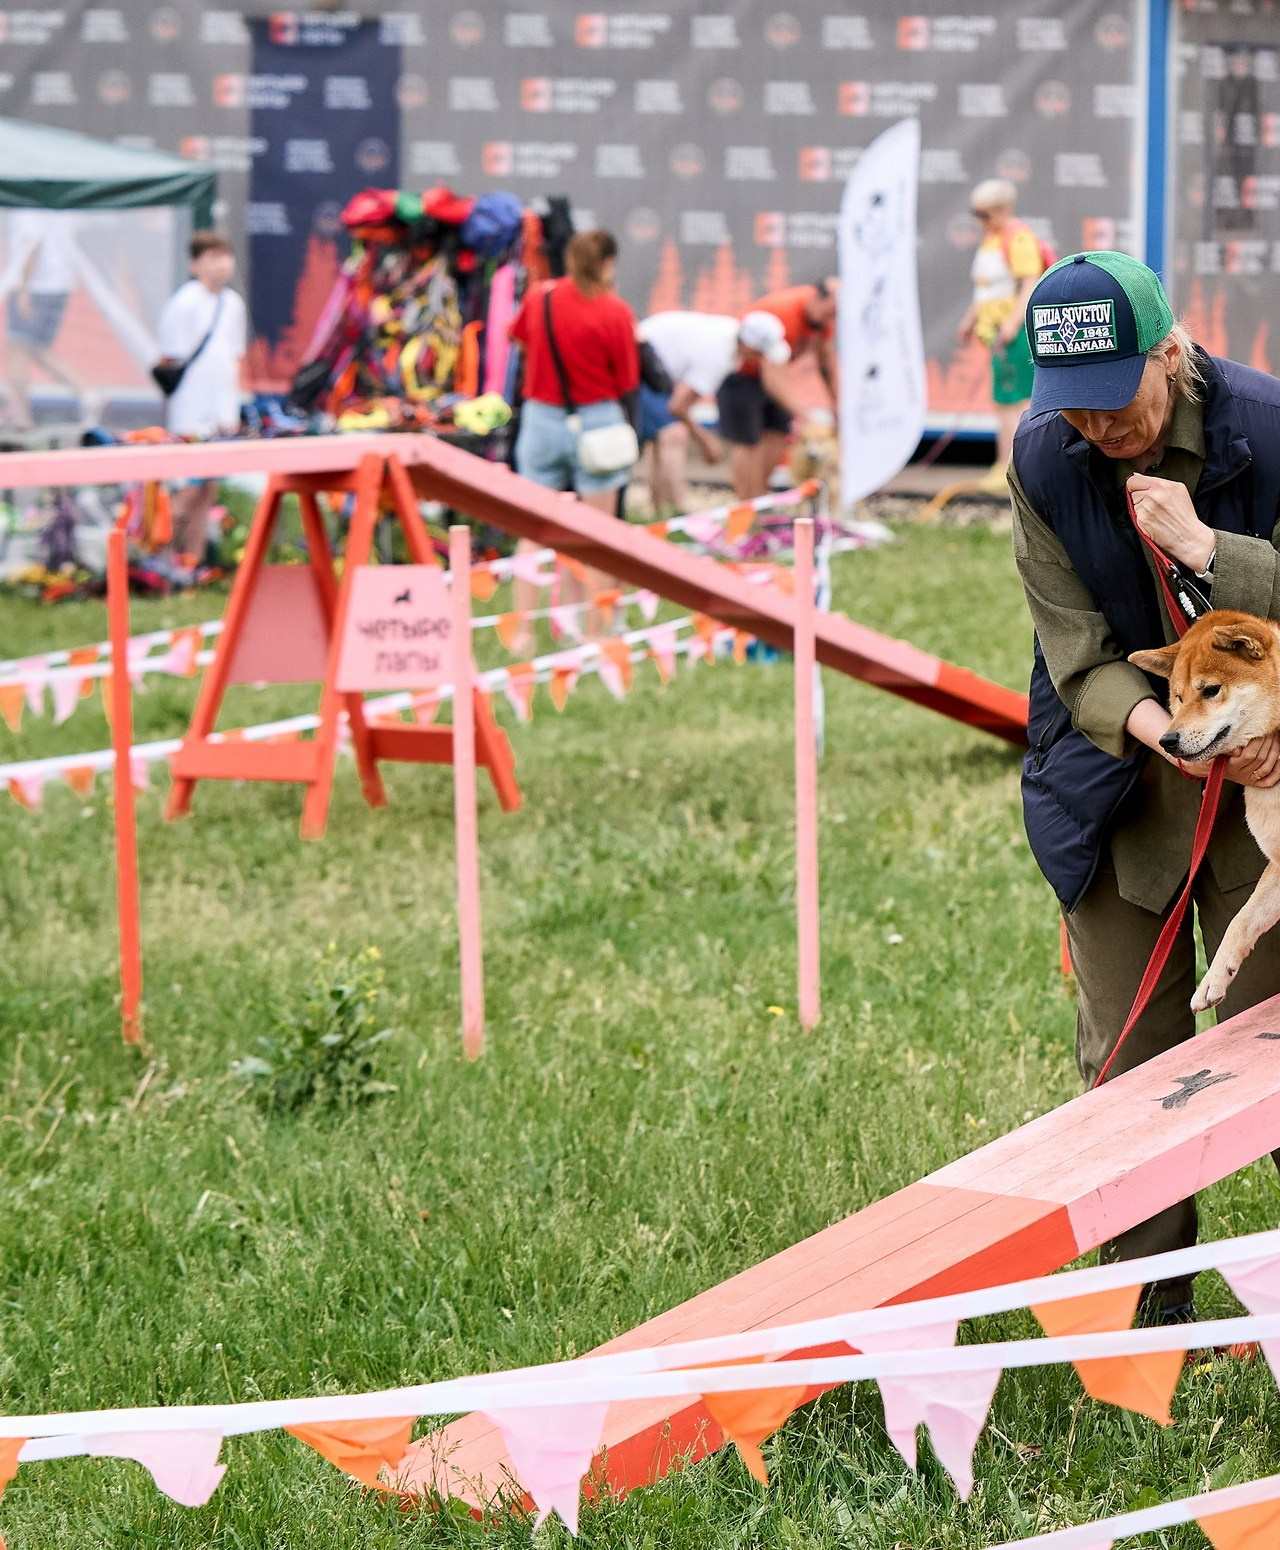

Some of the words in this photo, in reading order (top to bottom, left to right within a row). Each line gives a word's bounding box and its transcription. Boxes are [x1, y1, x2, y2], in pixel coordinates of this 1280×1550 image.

[1062, 303, 1111, 324] SOVETOV
[1037, 332, 1054, 342] EST.
[1083, 327, 1110, 338] 1942
[1067, 339, 1114, 353] SAMARA
